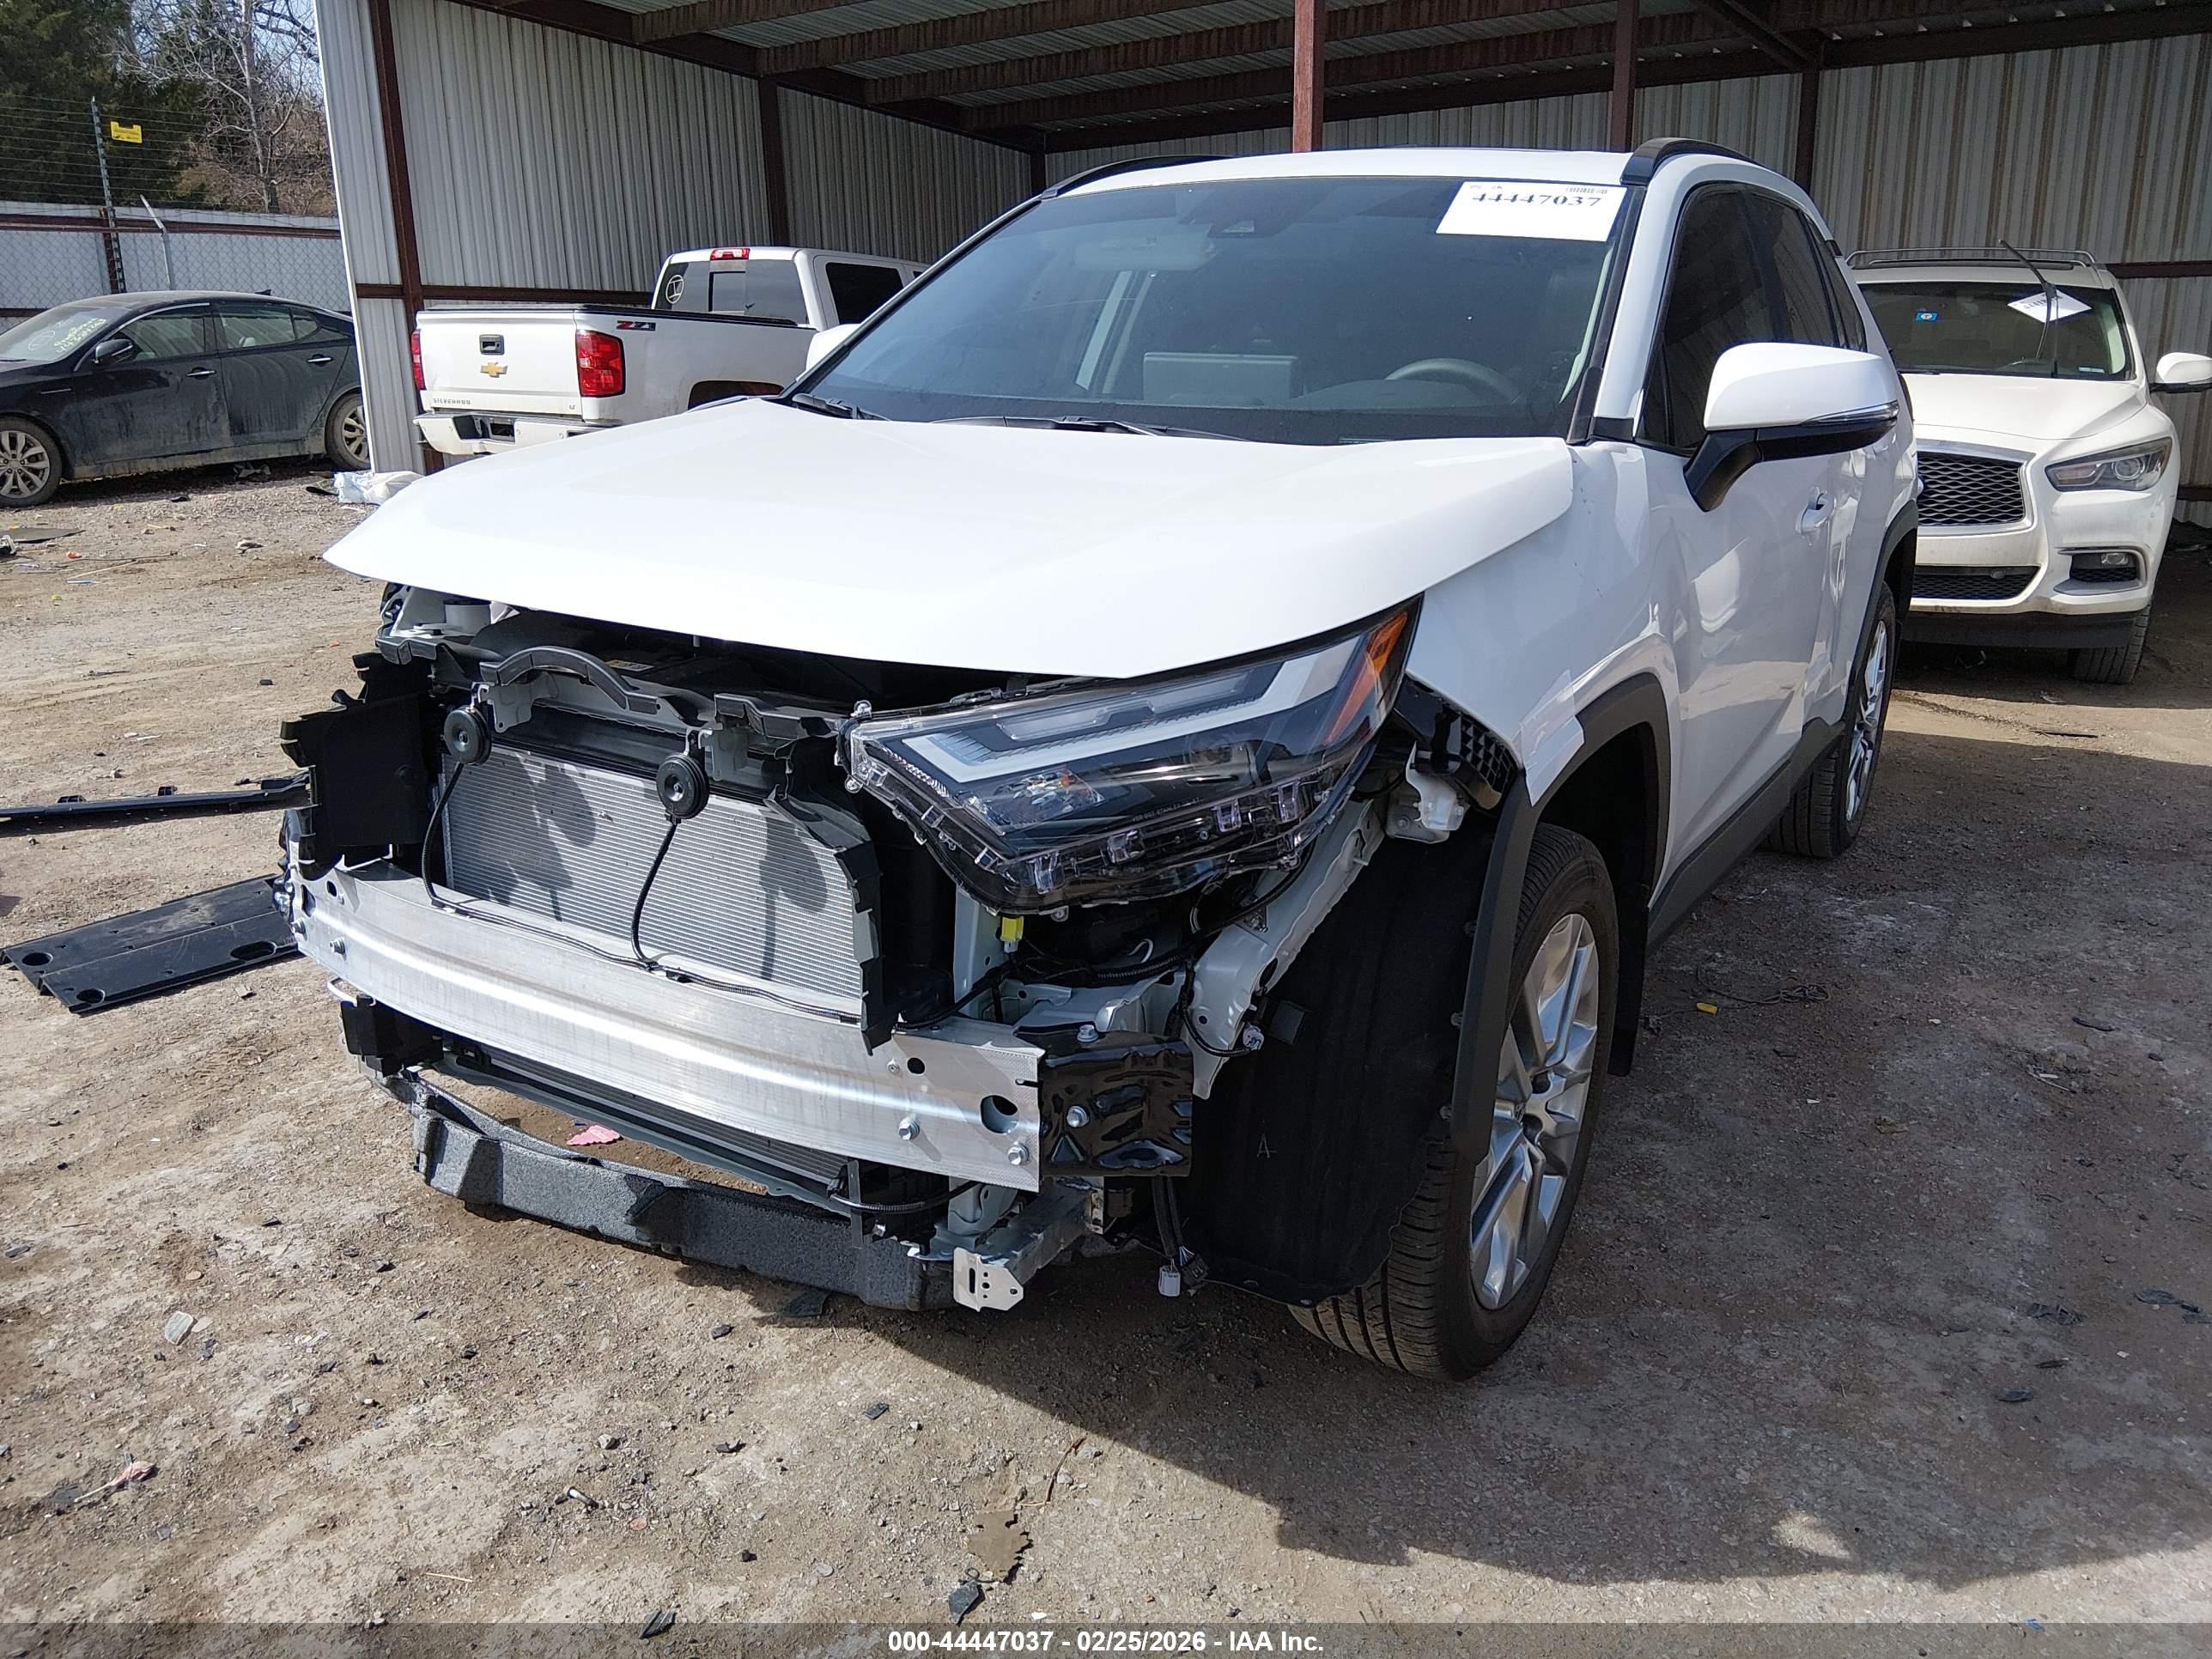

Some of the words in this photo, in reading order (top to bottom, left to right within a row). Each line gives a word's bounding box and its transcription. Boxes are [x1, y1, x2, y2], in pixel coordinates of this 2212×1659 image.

[1472, 193, 1601, 207] 44447037
[617, 319, 656, 331] Z71
[1256, 1133, 1277, 1158] A
